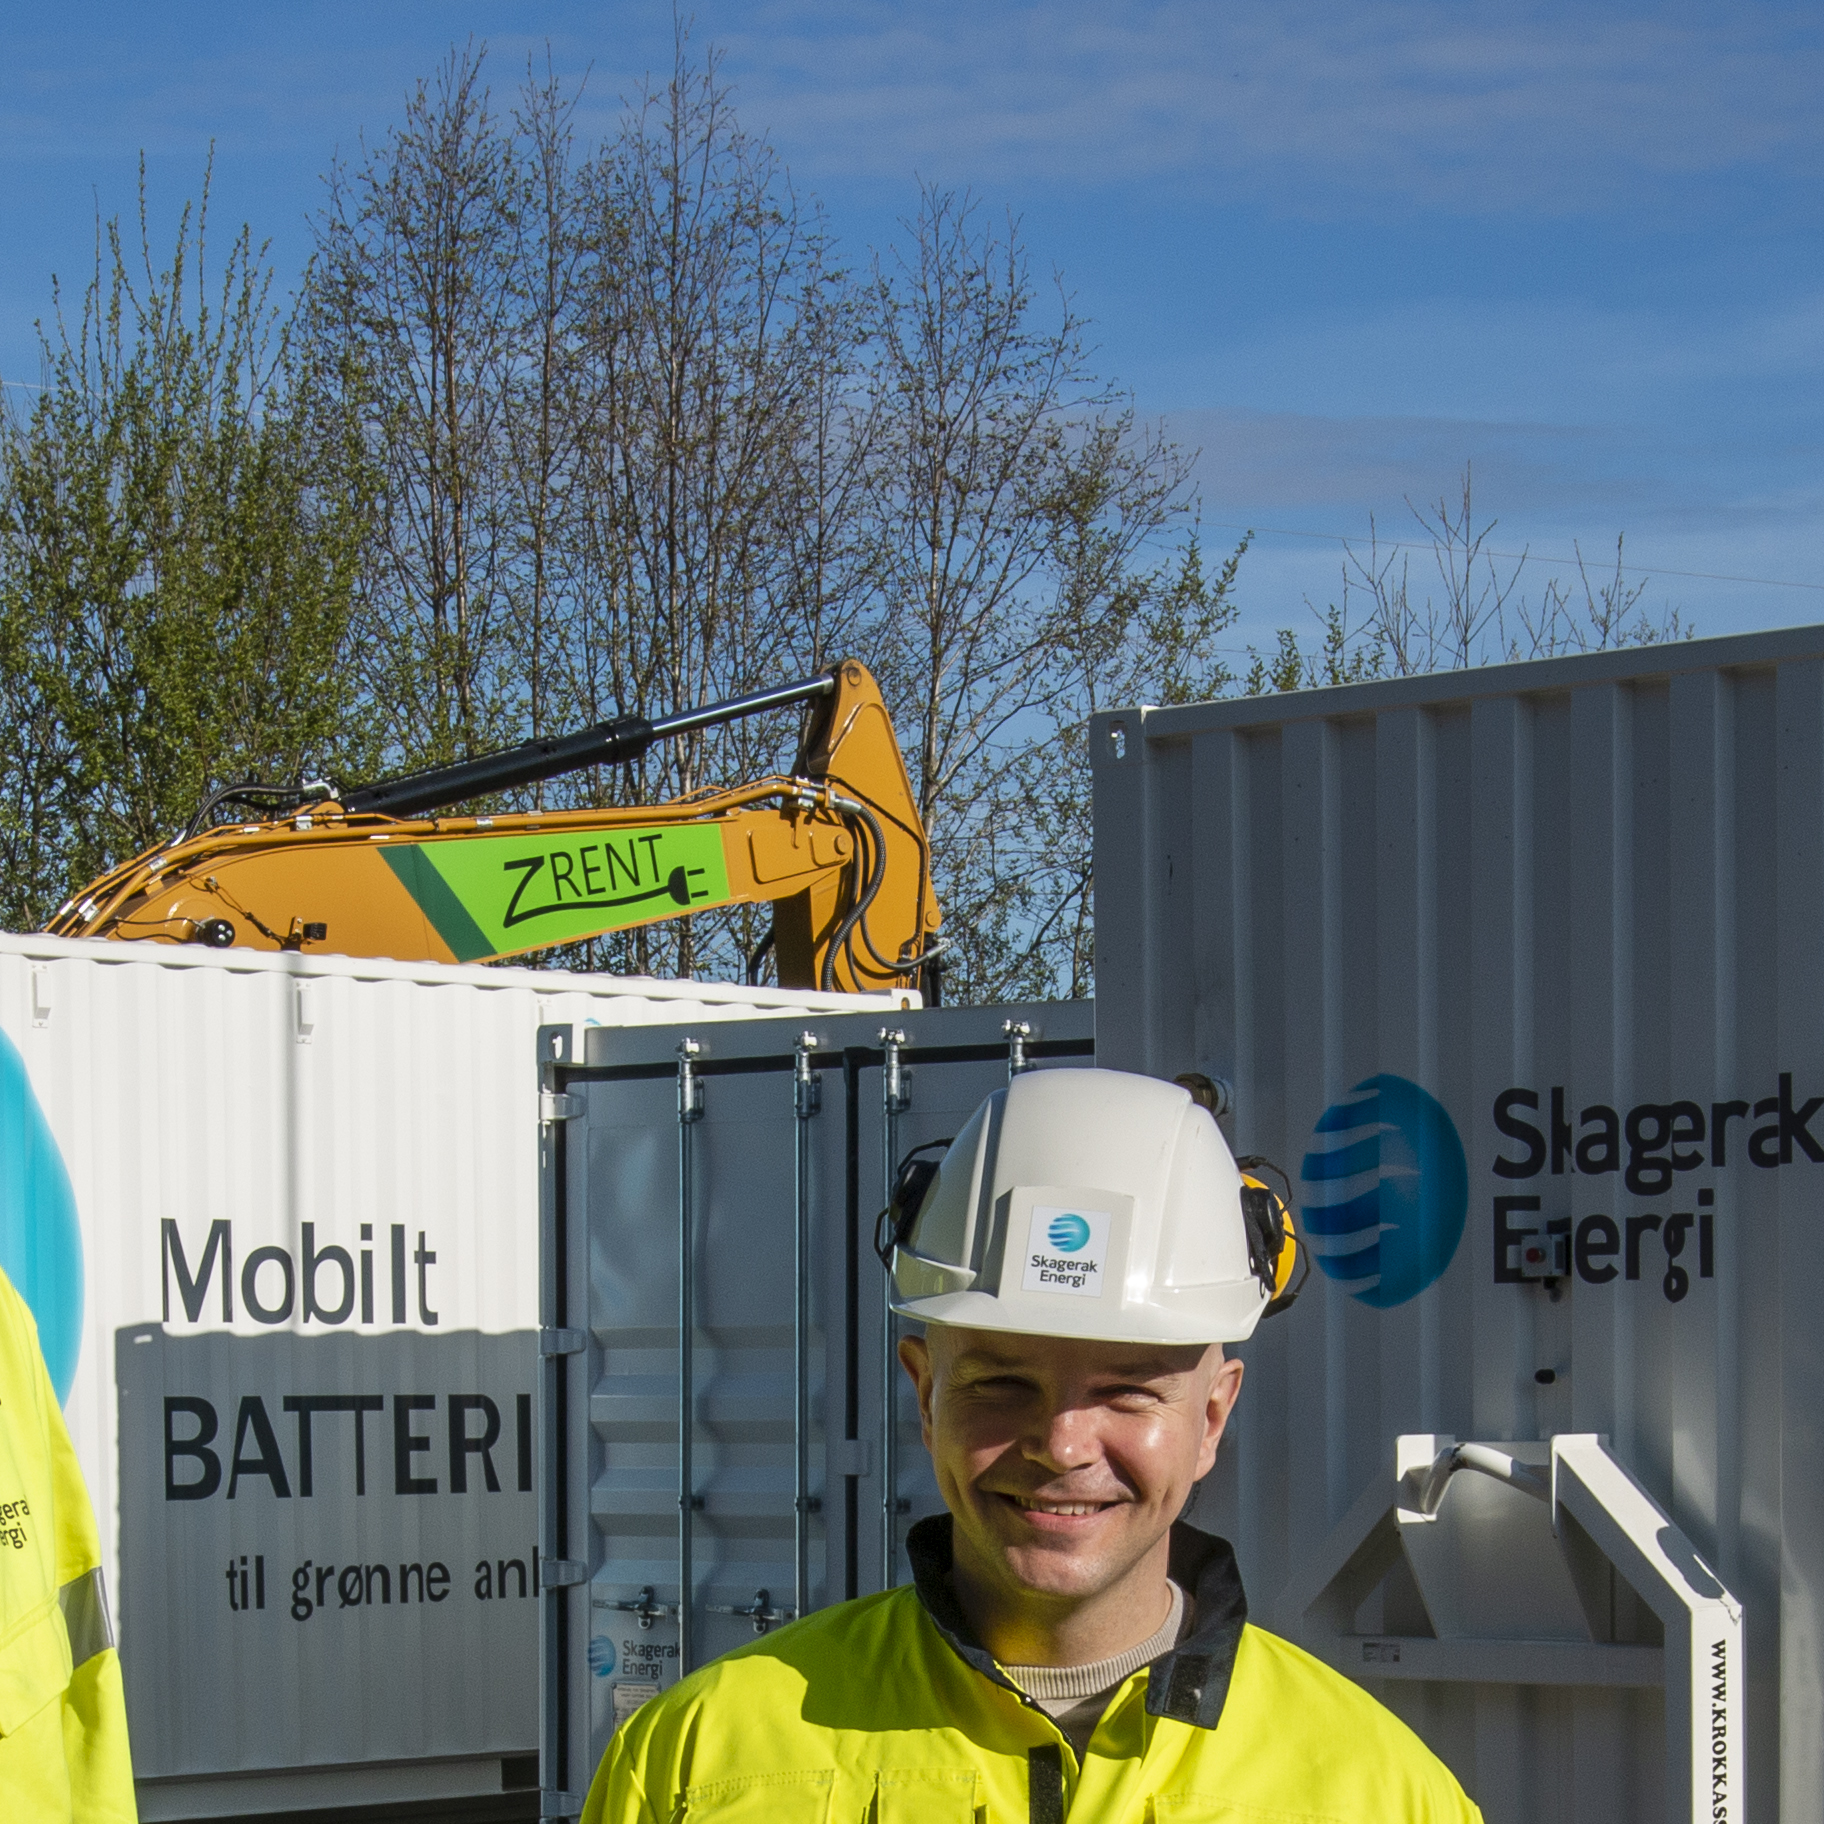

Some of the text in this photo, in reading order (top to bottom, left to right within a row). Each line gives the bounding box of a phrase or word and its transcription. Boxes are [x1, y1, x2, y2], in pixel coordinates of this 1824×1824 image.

[160, 1217, 439, 1327] Mobilt
[1030, 1253, 1098, 1276] Skagerak
[1038, 1267, 1087, 1288] Energi
[1493, 1187, 1715, 1303] Eergi
[162, 1393, 533, 1502] BATTERI
[225, 1555, 266, 1612] til
[290, 1559, 451, 1622] grønne
[622, 1658, 663, 1680] Energi
